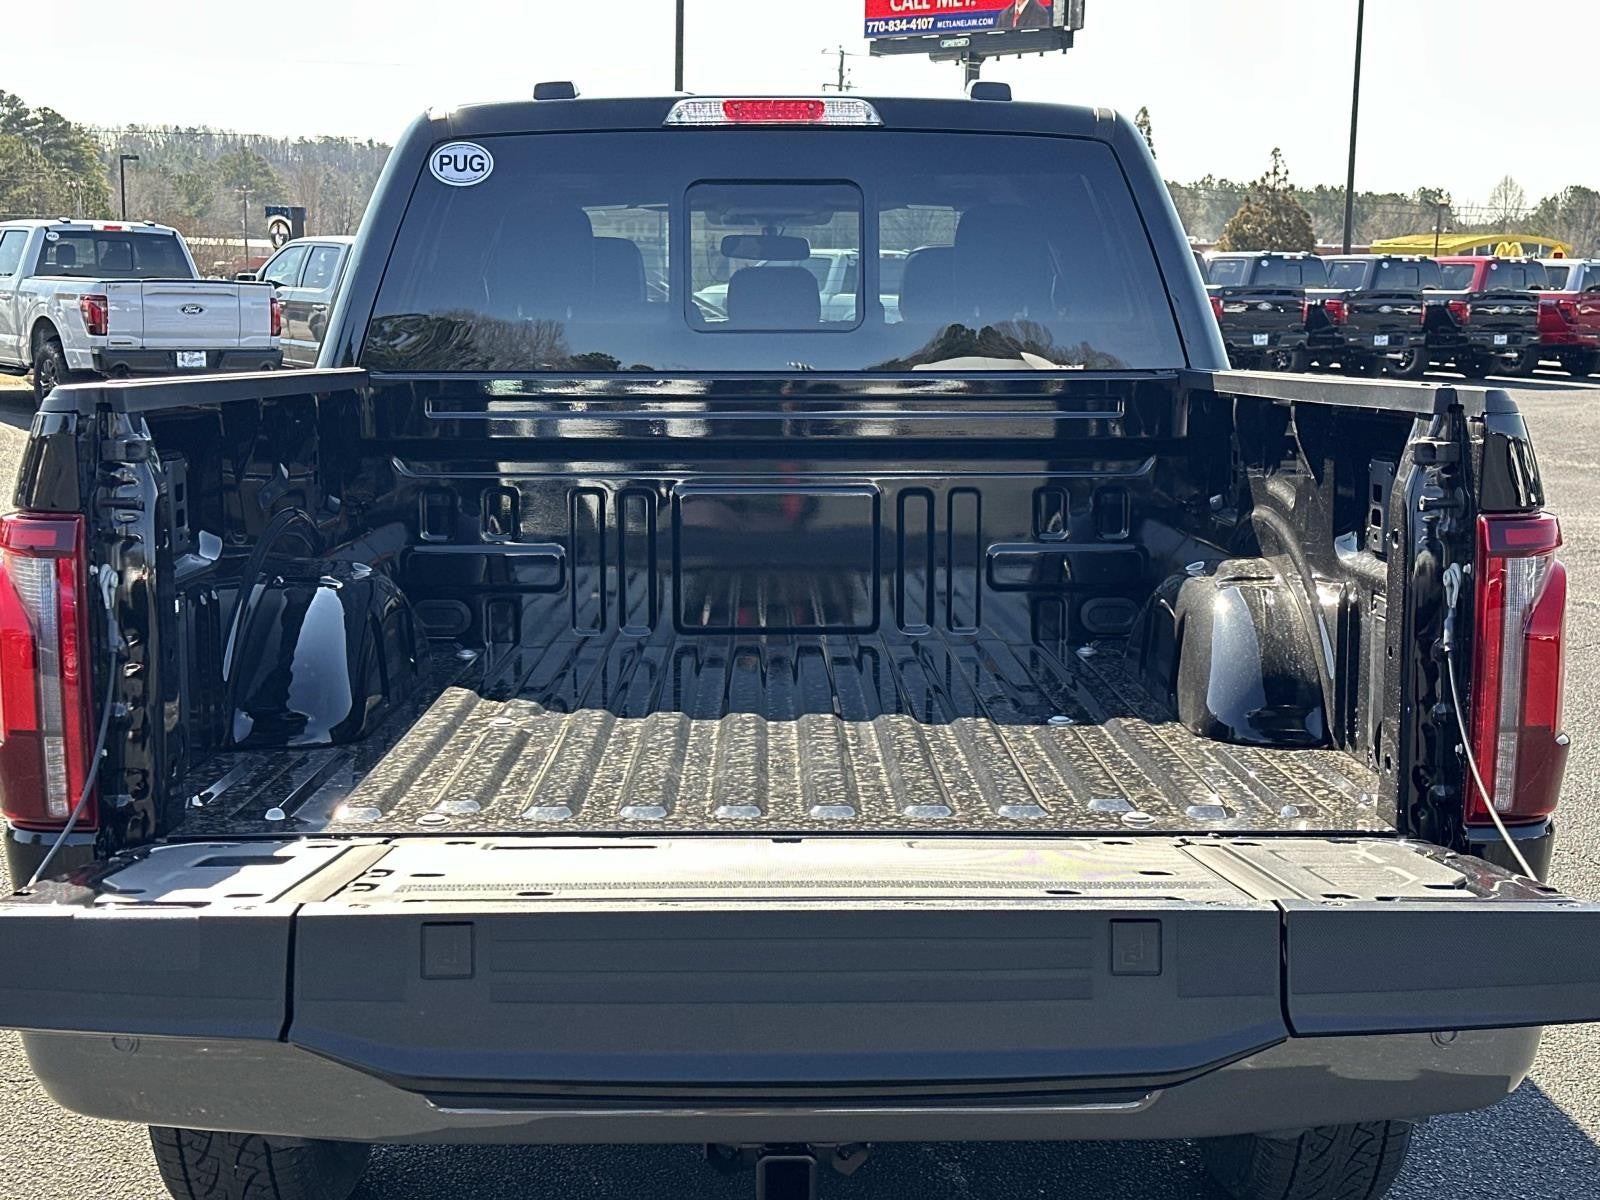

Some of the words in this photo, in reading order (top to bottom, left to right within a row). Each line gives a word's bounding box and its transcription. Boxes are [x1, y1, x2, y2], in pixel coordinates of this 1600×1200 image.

[889, 0, 931, 12] CALL
[866, 17, 935, 33] 770-834-4107
[937, 17, 994, 28] METLANELAW.COM
[439, 154, 485, 172] PUG
